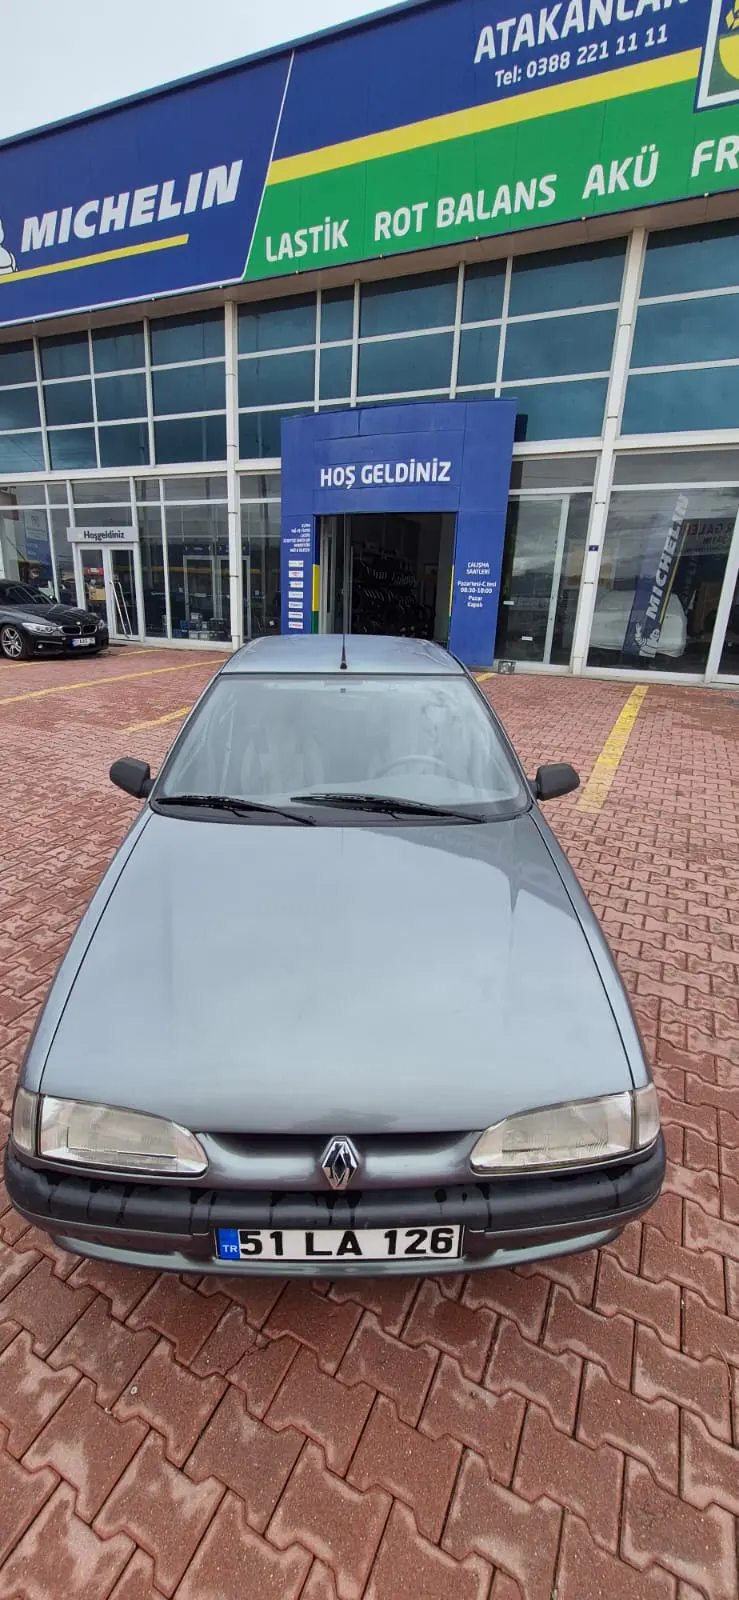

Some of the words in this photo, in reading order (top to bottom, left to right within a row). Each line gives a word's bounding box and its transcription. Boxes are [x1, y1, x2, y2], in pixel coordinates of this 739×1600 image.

[474, 0, 689, 63] ATAKANL
[495, 65, 522, 87] Tel:
[526, 52, 571, 78] 0388
[576, 41, 609, 65] 221
[615, 32, 638, 56] 11
[644, 24, 668, 47] 11
[21, 159, 243, 252] MICHELIN
[265, 216, 350, 262] LASTİK
[374, 202, 428, 241] ROT
[436, 174, 557, 228] BALANS
[582, 143, 659, 199] AKÜ
[320, 465, 356, 489] HOŞ
[361, 458, 451, 484] GELDİNİZ
[646, 494, 689, 620] MICHELIN
[222, 1244, 239, 1253] TR
[239, 1230, 284, 1256] 51
[305, 1230, 363, 1256] LA
[384, 1227, 455, 1255] 126
